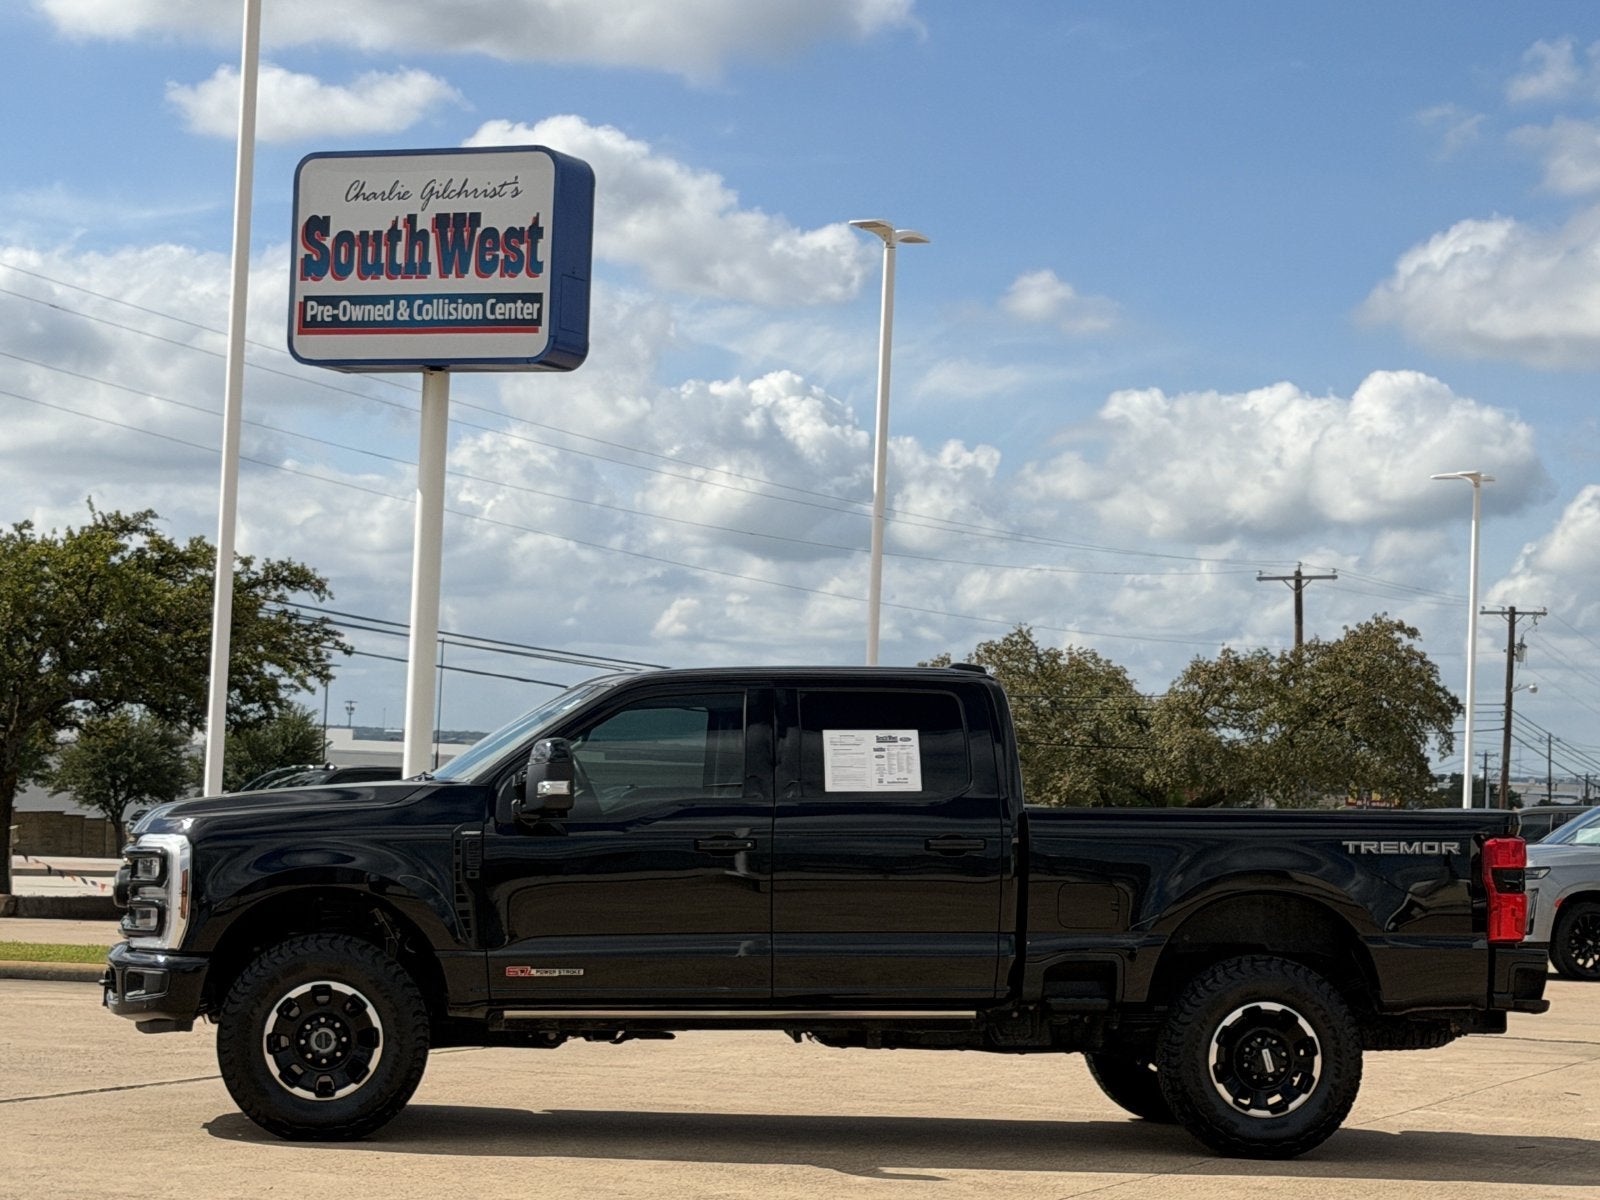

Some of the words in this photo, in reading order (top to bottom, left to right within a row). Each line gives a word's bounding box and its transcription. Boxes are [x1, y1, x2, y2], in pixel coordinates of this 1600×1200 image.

[345, 180, 413, 203] Charlie
[421, 175, 523, 212] Gilchrist's
[306, 300, 394, 322] Pre-Owned
[396, 300, 411, 321] &
[413, 299, 483, 320] Collision
[485, 298, 541, 320] Center
[1342, 841, 1461, 855] TREMOR
